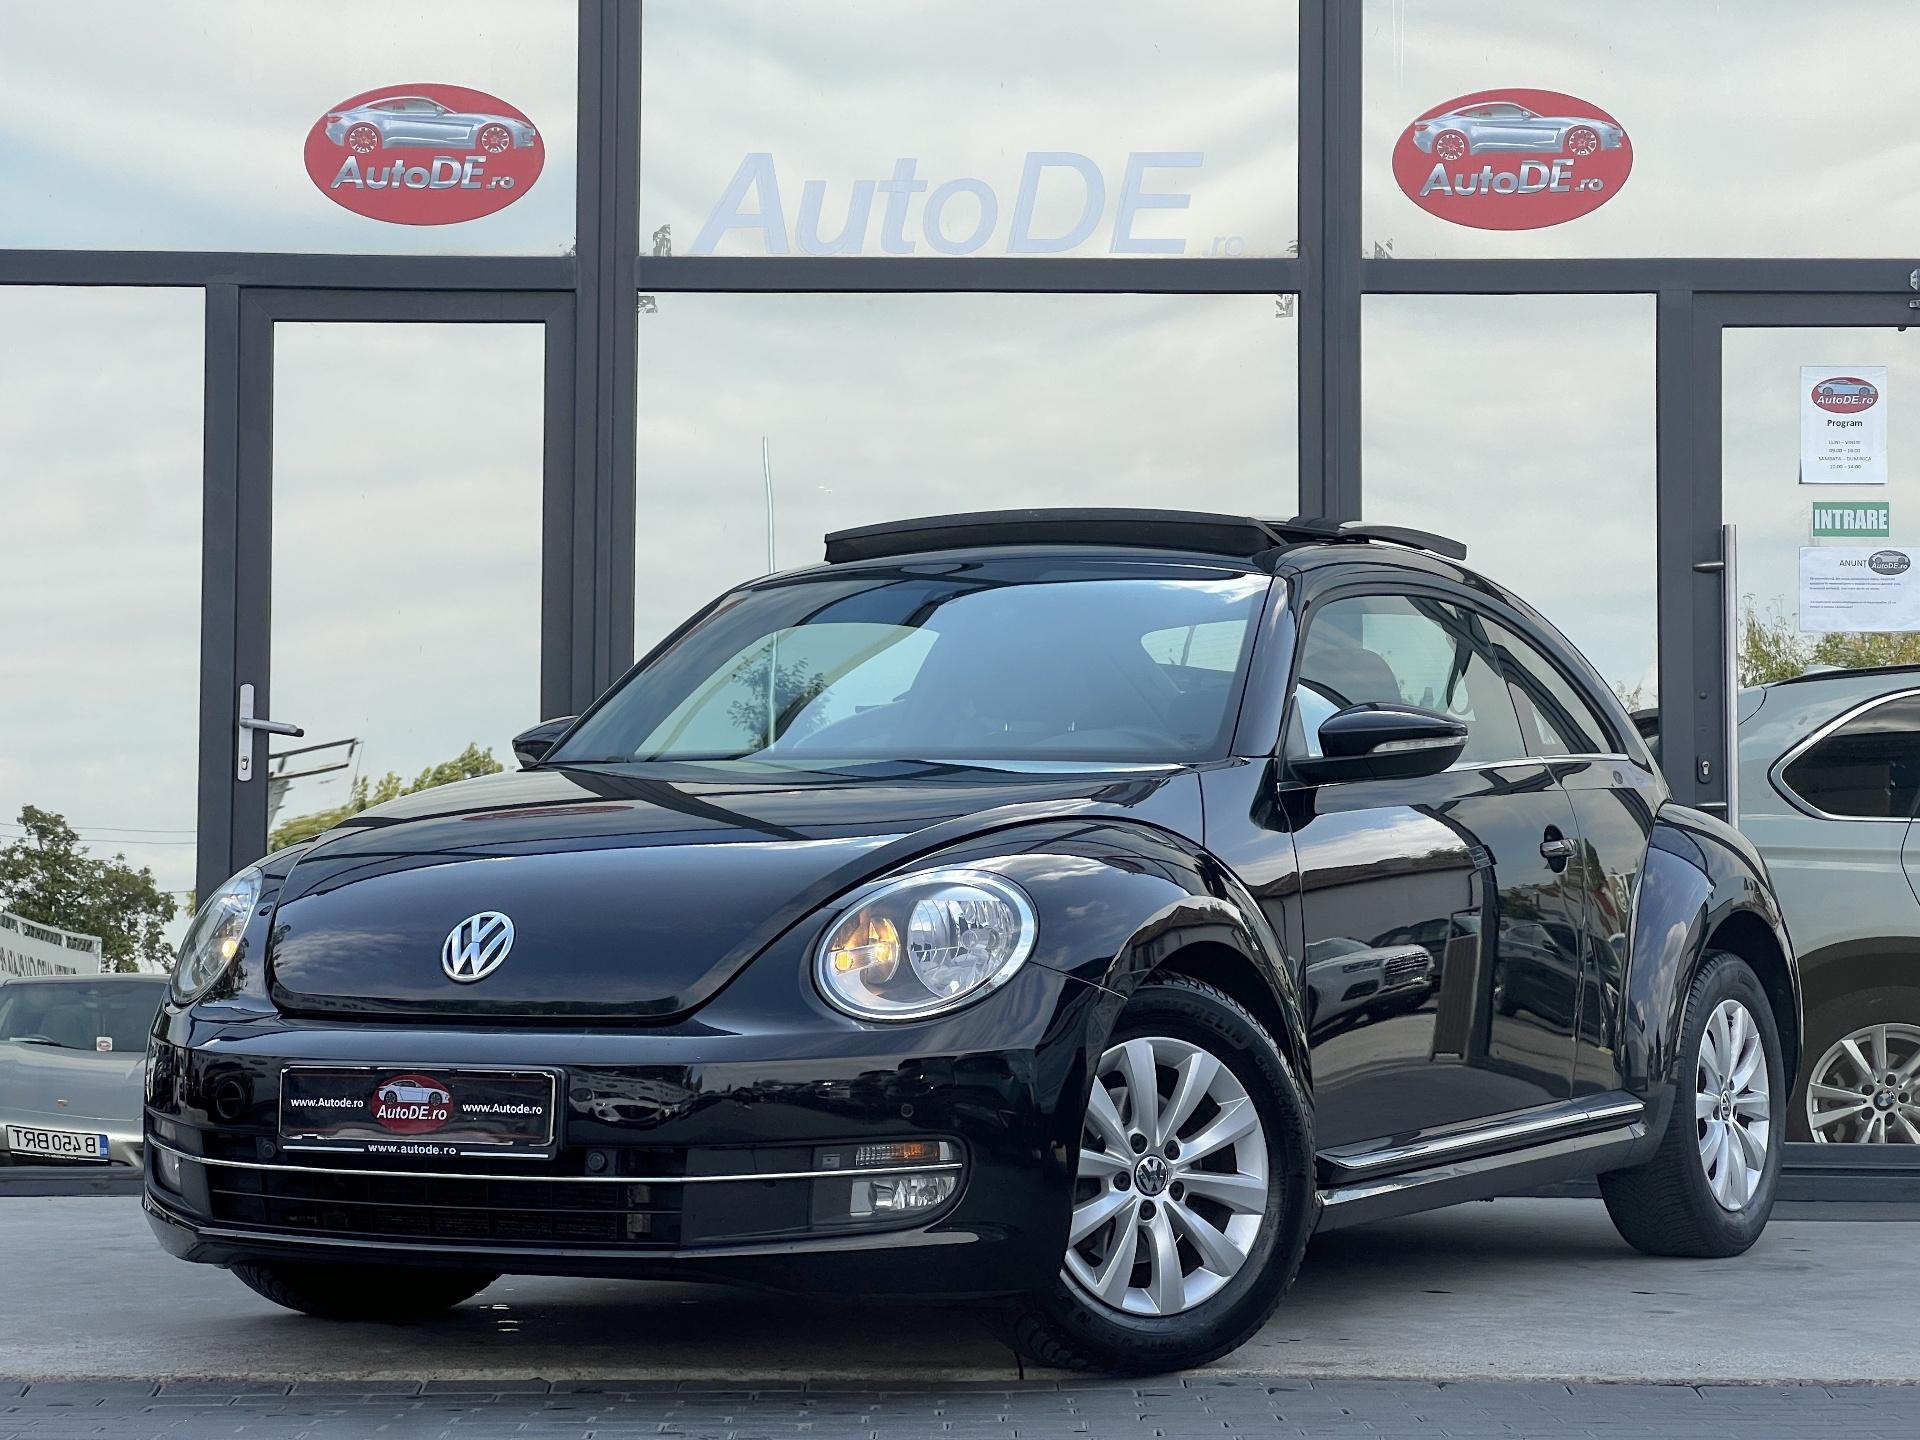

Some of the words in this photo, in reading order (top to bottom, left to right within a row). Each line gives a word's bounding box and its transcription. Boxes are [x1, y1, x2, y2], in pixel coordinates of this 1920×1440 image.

[1817, 395, 1874, 405] AutoDE.ro
[1827, 419, 1863, 428] Program
[1814, 509, 1888, 529] INTRARE
[290, 1097, 364, 1108] www.Autode.ro
[376, 1104, 448, 1121] AutoDE.ro
[462, 1103, 543, 1115] www.Autode.ro
[367, 1143, 457, 1155] www.autode.ro
